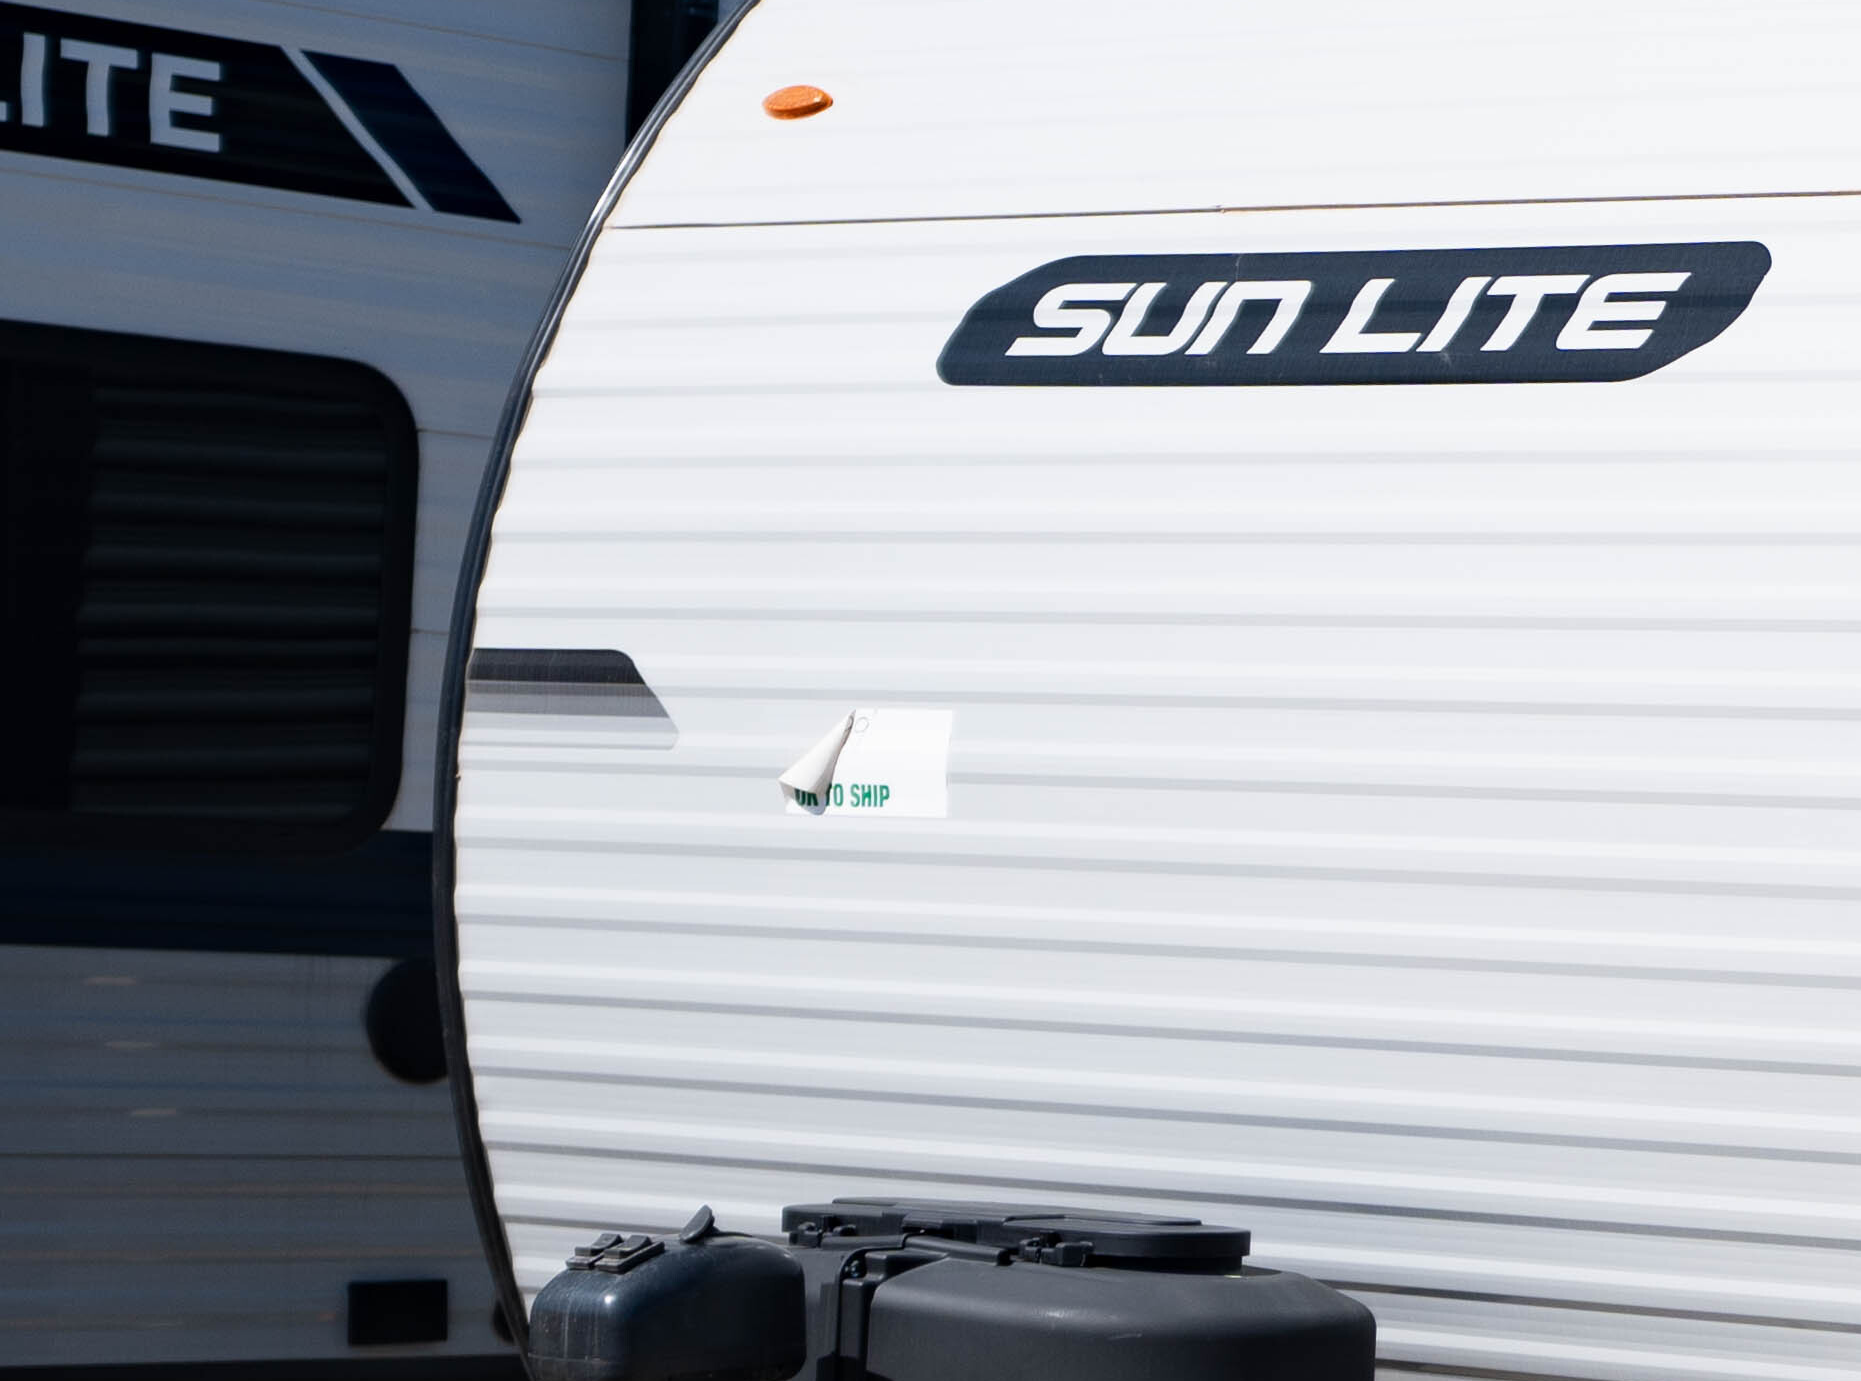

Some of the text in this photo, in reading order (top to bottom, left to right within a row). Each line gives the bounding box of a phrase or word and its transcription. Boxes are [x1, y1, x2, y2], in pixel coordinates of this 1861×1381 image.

[0, 31, 221, 154] ITE
[1004, 271, 1692, 358] SUN LITE
[850, 783, 891, 808] SHIP
